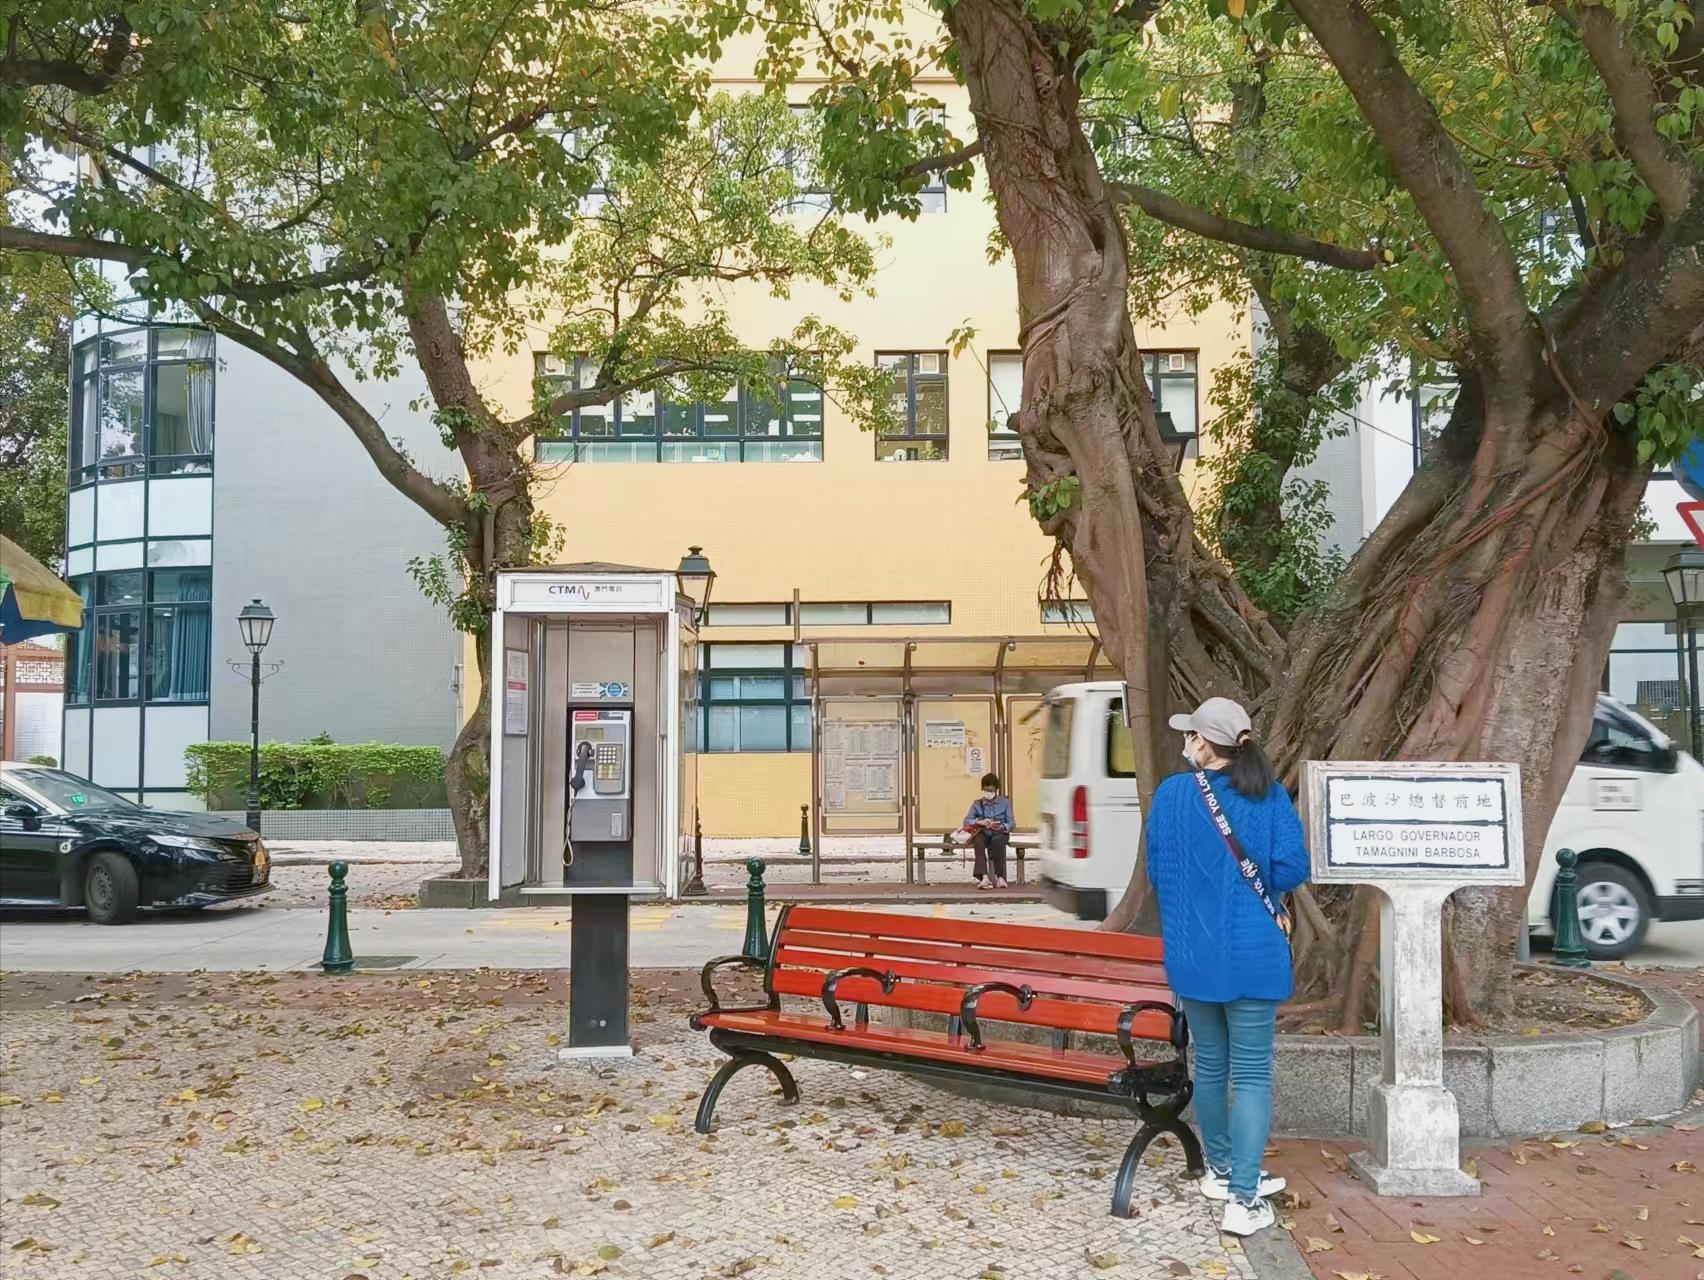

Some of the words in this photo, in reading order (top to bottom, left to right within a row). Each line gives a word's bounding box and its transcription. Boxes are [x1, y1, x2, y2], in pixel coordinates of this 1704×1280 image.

[548, 585, 576, 594] CTM
[1205, 792, 1220, 814] YOU
[1340, 792, 1493, 809] 巴波沙總督前地
[1215, 813, 1232, 836] SEE
[1353, 829, 1394, 842] LARGO
[1400, 829, 1481, 842] GOVERNADOR
[1355, 846, 1419, 858] TAMAGNINI
[1425, 847, 1481, 859] BARBOSA
